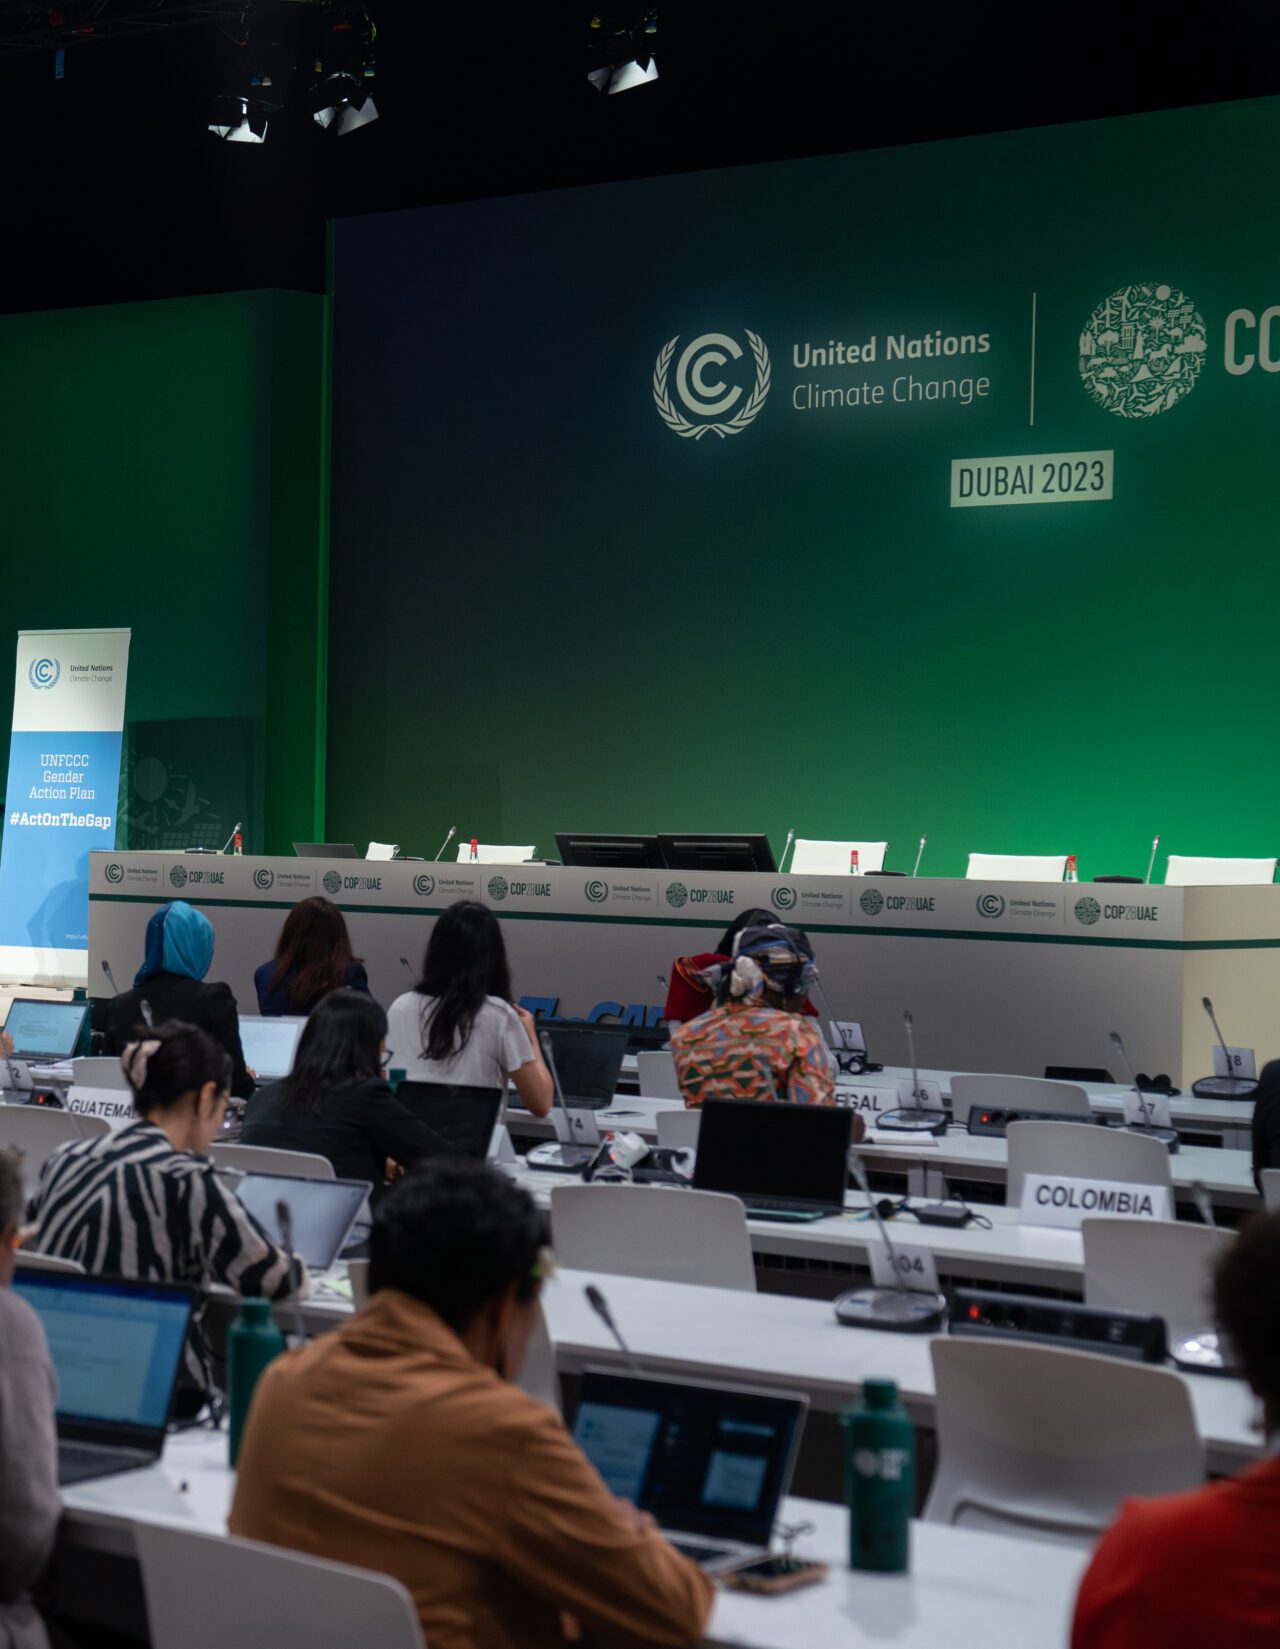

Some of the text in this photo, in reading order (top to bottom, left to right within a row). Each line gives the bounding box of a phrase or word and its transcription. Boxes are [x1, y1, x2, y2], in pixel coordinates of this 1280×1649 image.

[793, 330, 990, 368] United Nations
[793, 375, 990, 410] Climate Change
[959, 460, 1105, 498] DUBAI 2023
[70, 664, 113, 672] United Nations
[70, 674, 112, 684] Climate Change
[40, 754, 89, 767] UNFCCC
[43, 770, 84, 783] Gender
[28, 786, 95, 799] Action Plan
[9, 811, 112, 830] #ActOnTheGap
[631, 885, 651, 893] Nations
[801, 891, 843, 900] United Nations
[690, 889, 734, 904] COP28UAE
[886, 896, 935, 911] COP28UAE
[1010, 899, 1056, 908] United Nations
[1010, 909, 1056, 919] Climate Change
[1104, 904, 1158, 921] COP28UAE
[1035, 1184, 1154, 1216] COLOMBIA
